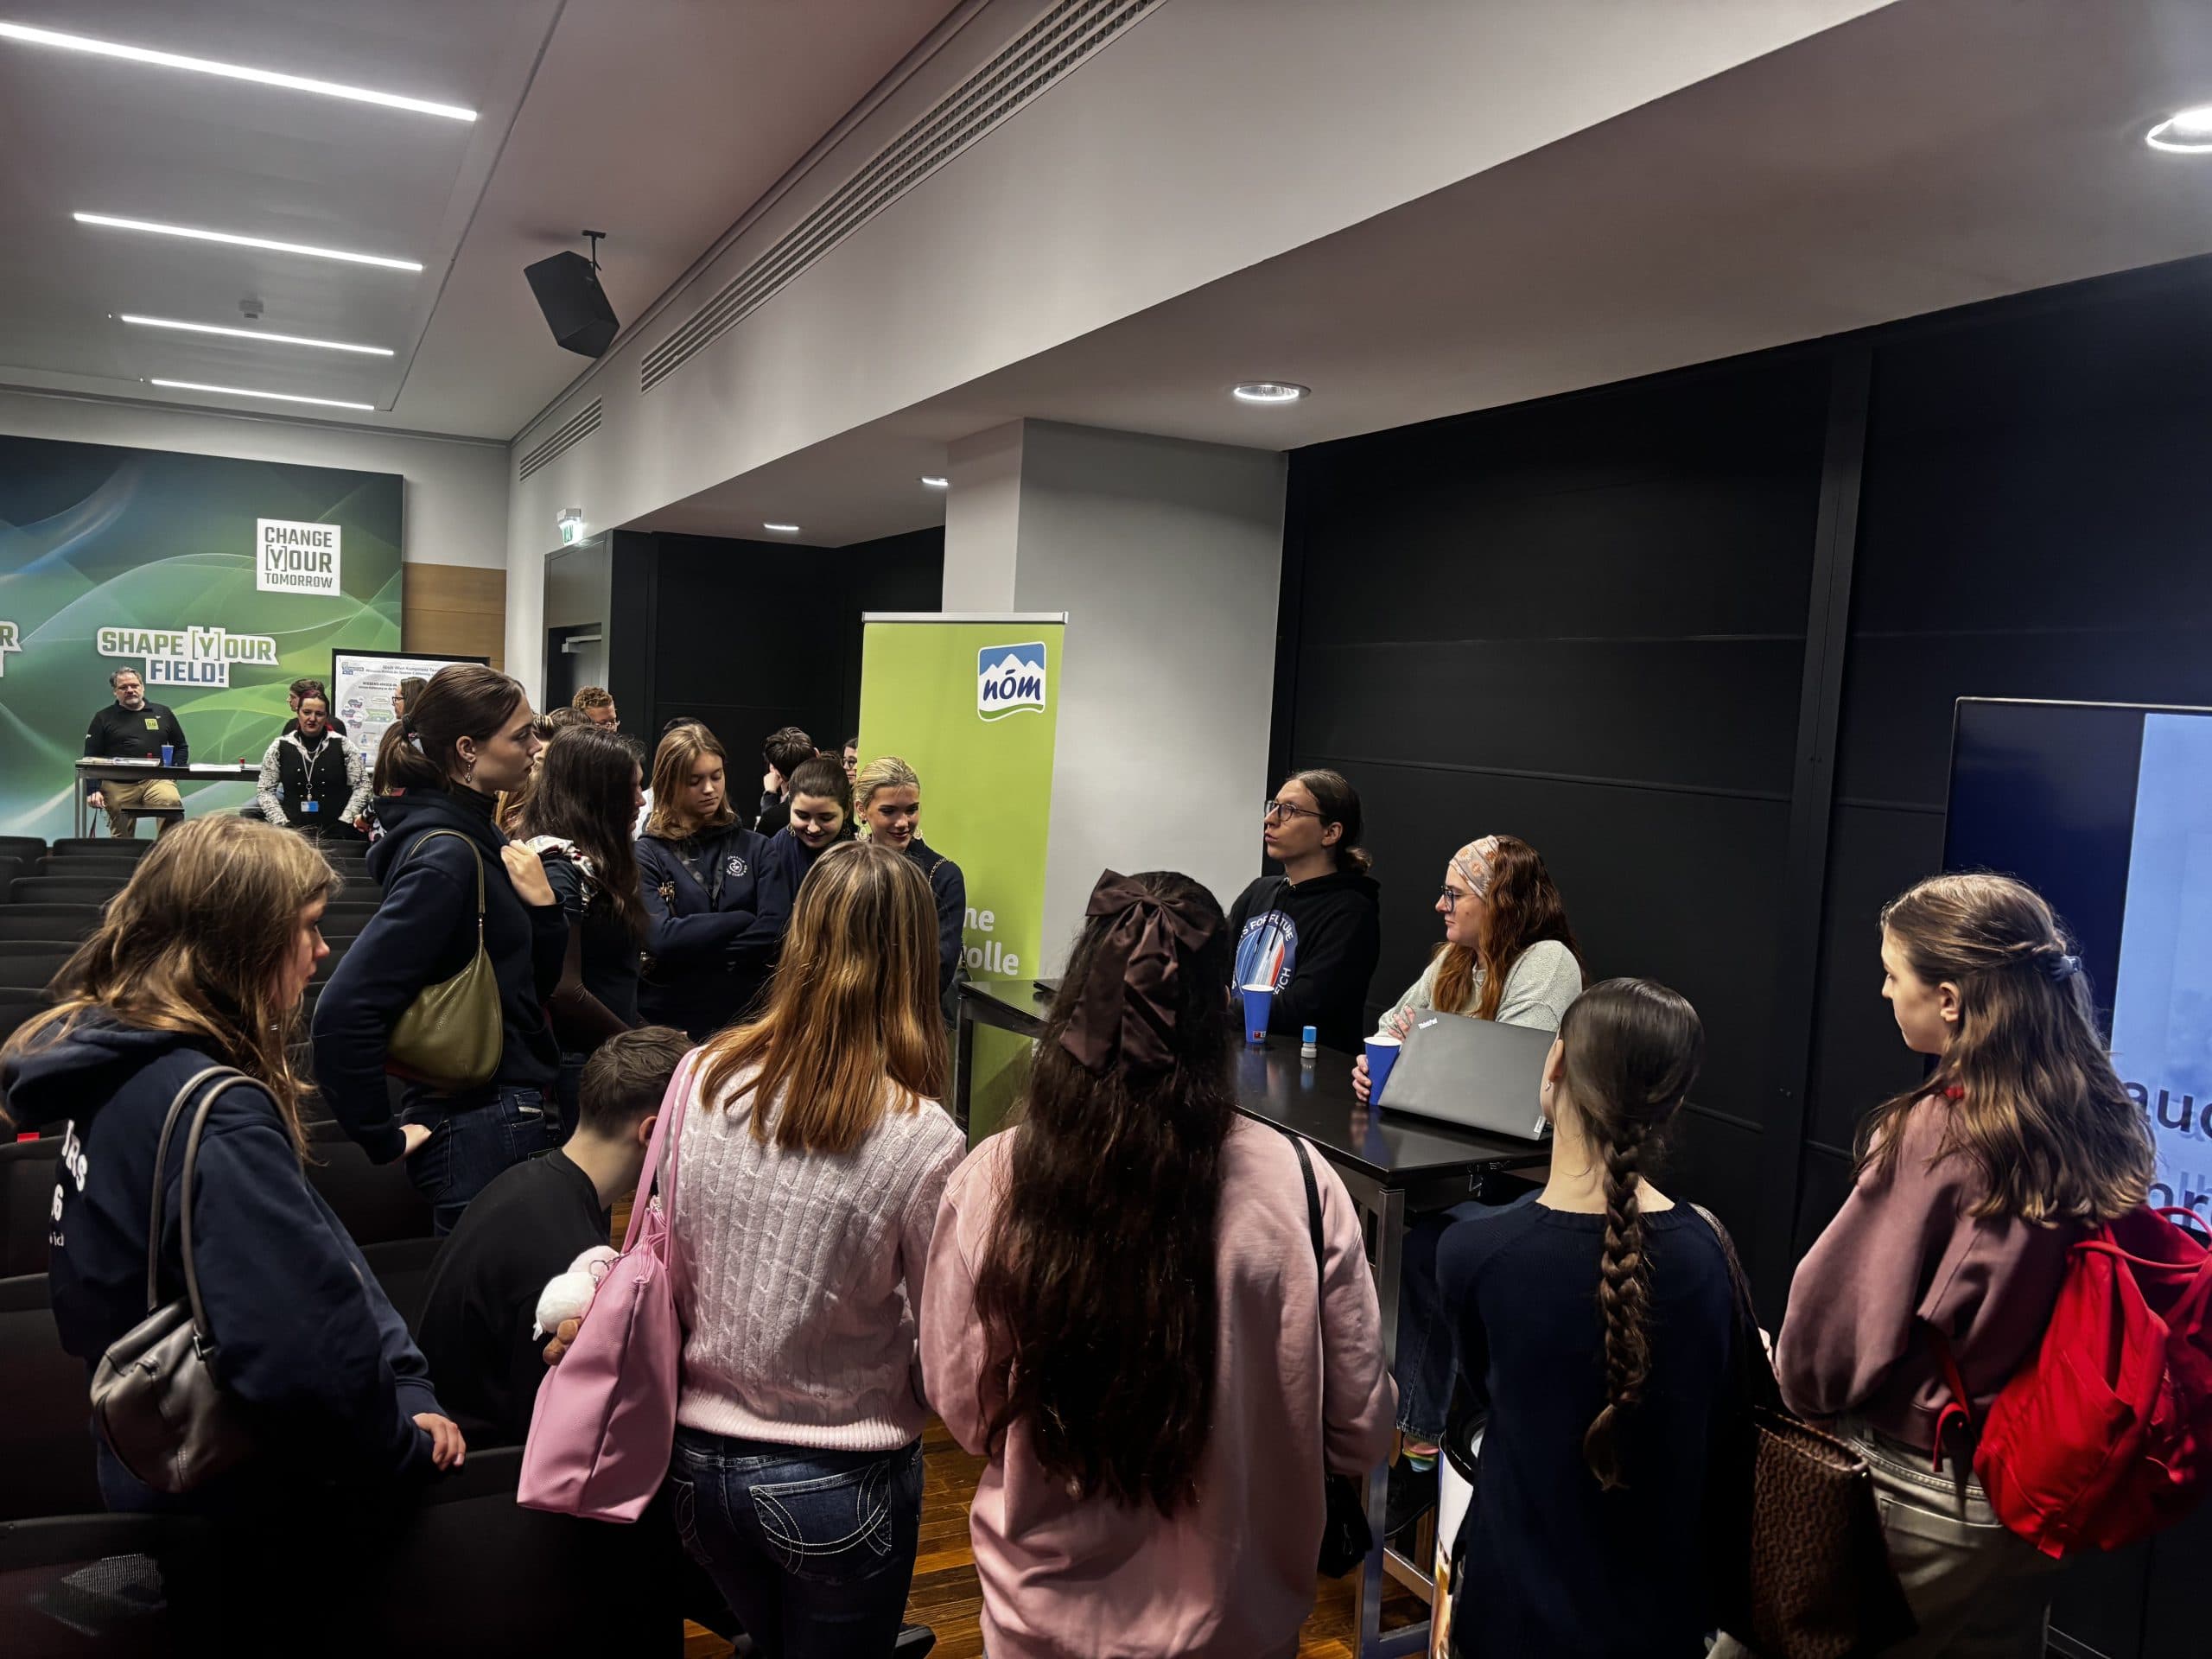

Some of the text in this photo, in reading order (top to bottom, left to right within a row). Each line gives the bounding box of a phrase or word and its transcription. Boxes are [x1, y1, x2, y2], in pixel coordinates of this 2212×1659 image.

[264, 526, 333, 548] CHANGE
[265, 544, 333, 573] [Y]OUR
[264, 572, 333, 588] TOMORROW
[102, 630, 271, 661] SHAPE [Y]OUR
[150, 659, 225, 683] FIELD!
[1273, 967, 1292, 995] EICH
